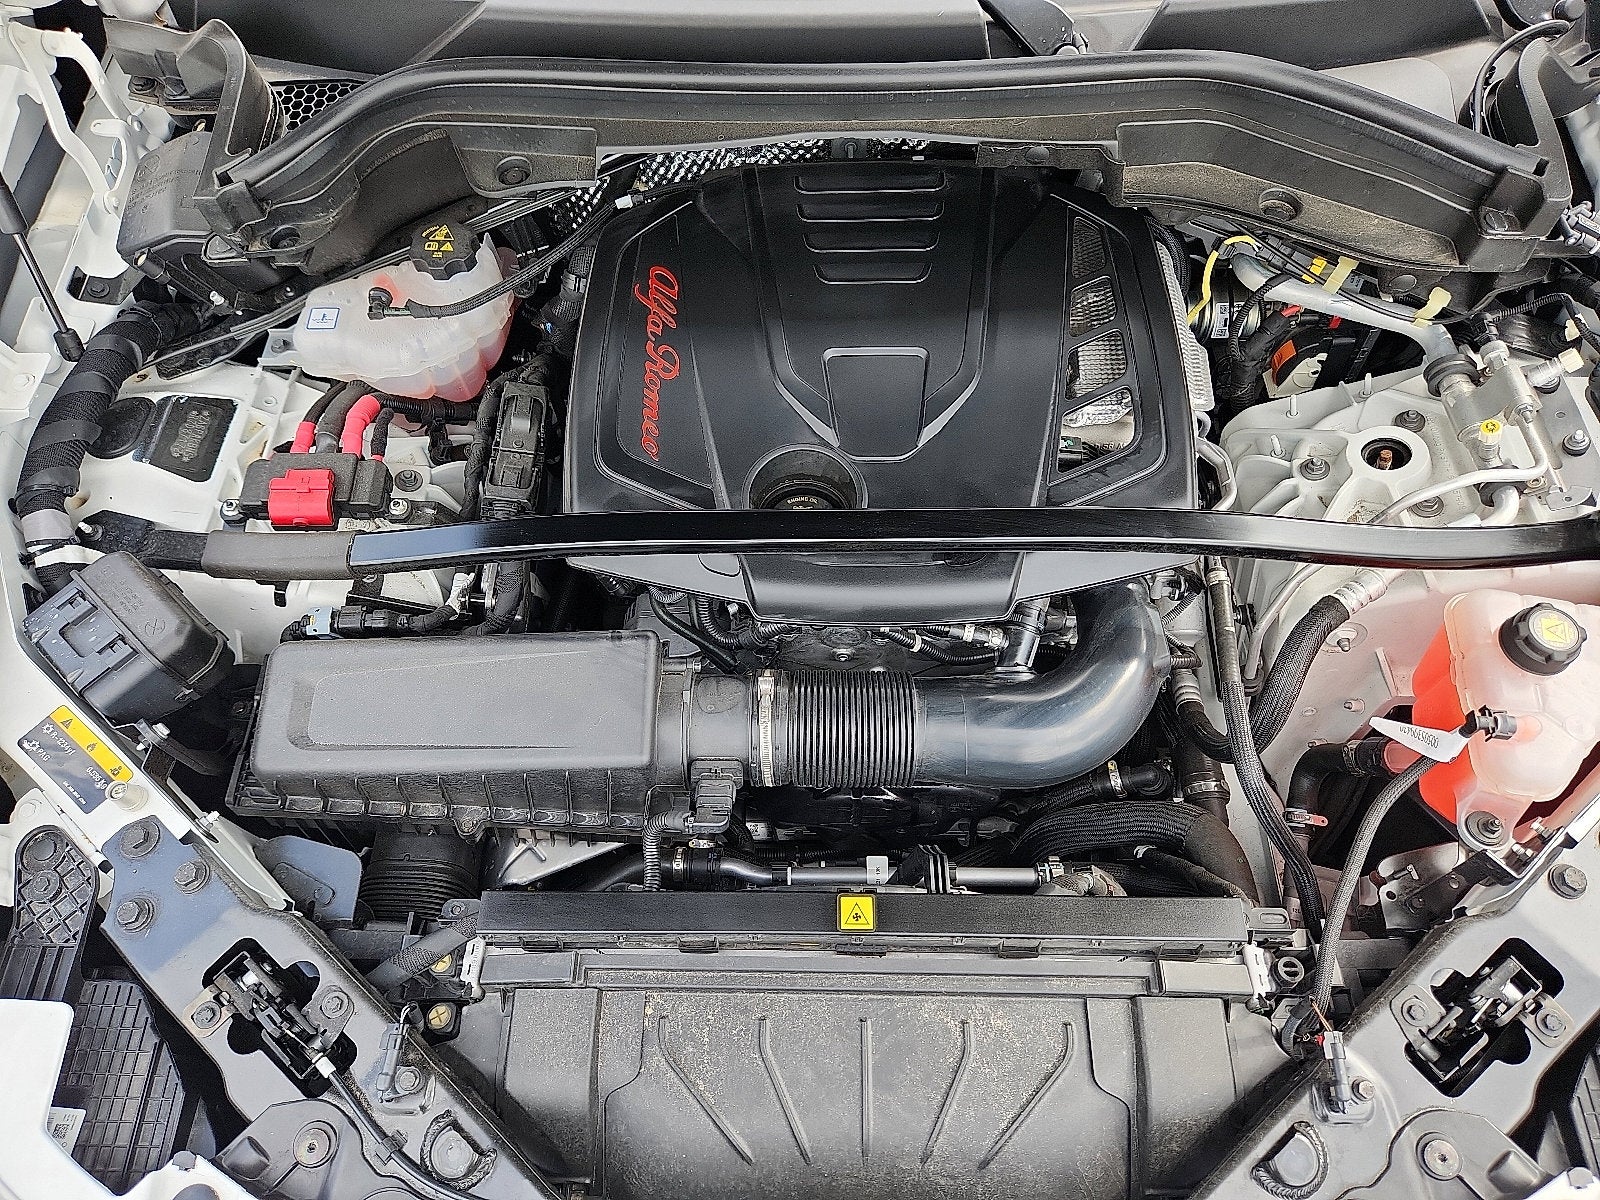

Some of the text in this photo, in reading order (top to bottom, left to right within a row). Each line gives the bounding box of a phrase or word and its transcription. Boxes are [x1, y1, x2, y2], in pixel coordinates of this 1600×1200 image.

[635, 265, 680, 461] Alfa Romeo
[36, 747, 51, 762] PAG
